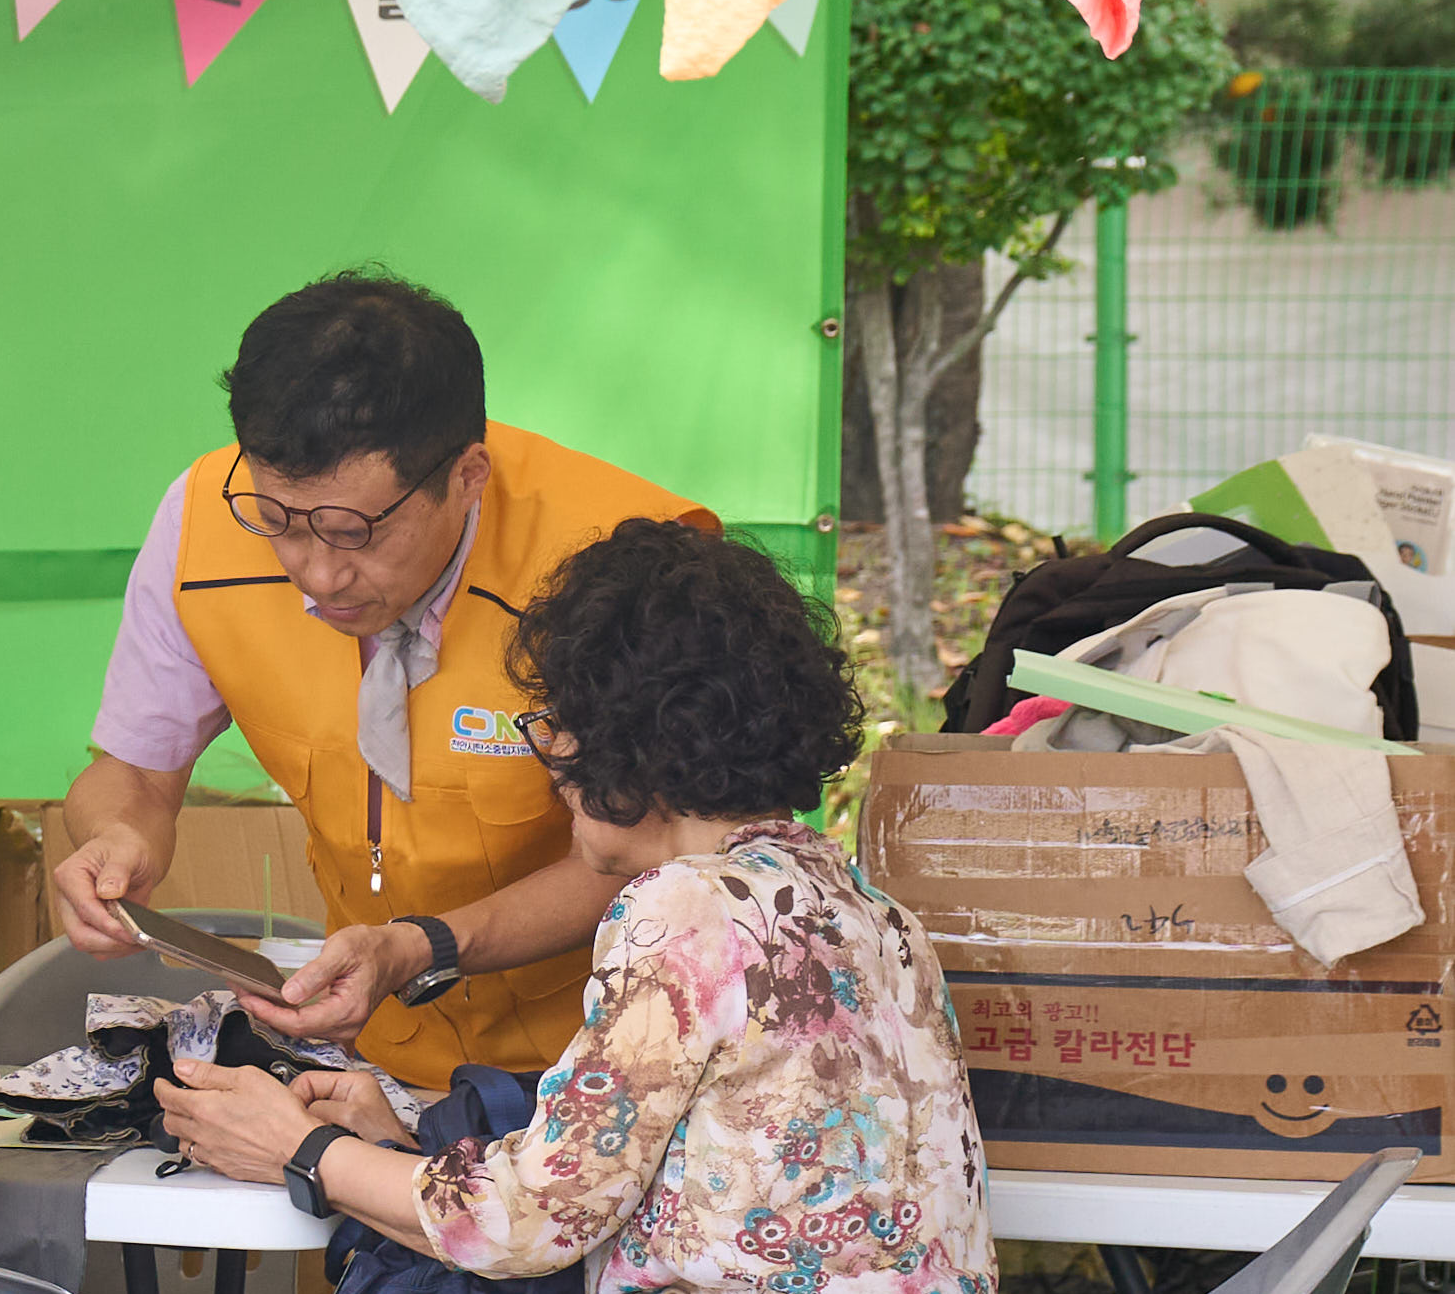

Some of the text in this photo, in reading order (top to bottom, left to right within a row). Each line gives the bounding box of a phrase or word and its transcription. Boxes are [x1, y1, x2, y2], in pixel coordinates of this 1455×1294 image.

[972, 999, 1100, 1024] 최고의 광고!!
[968, 1026, 1196, 1068] 고급 칼라전단
